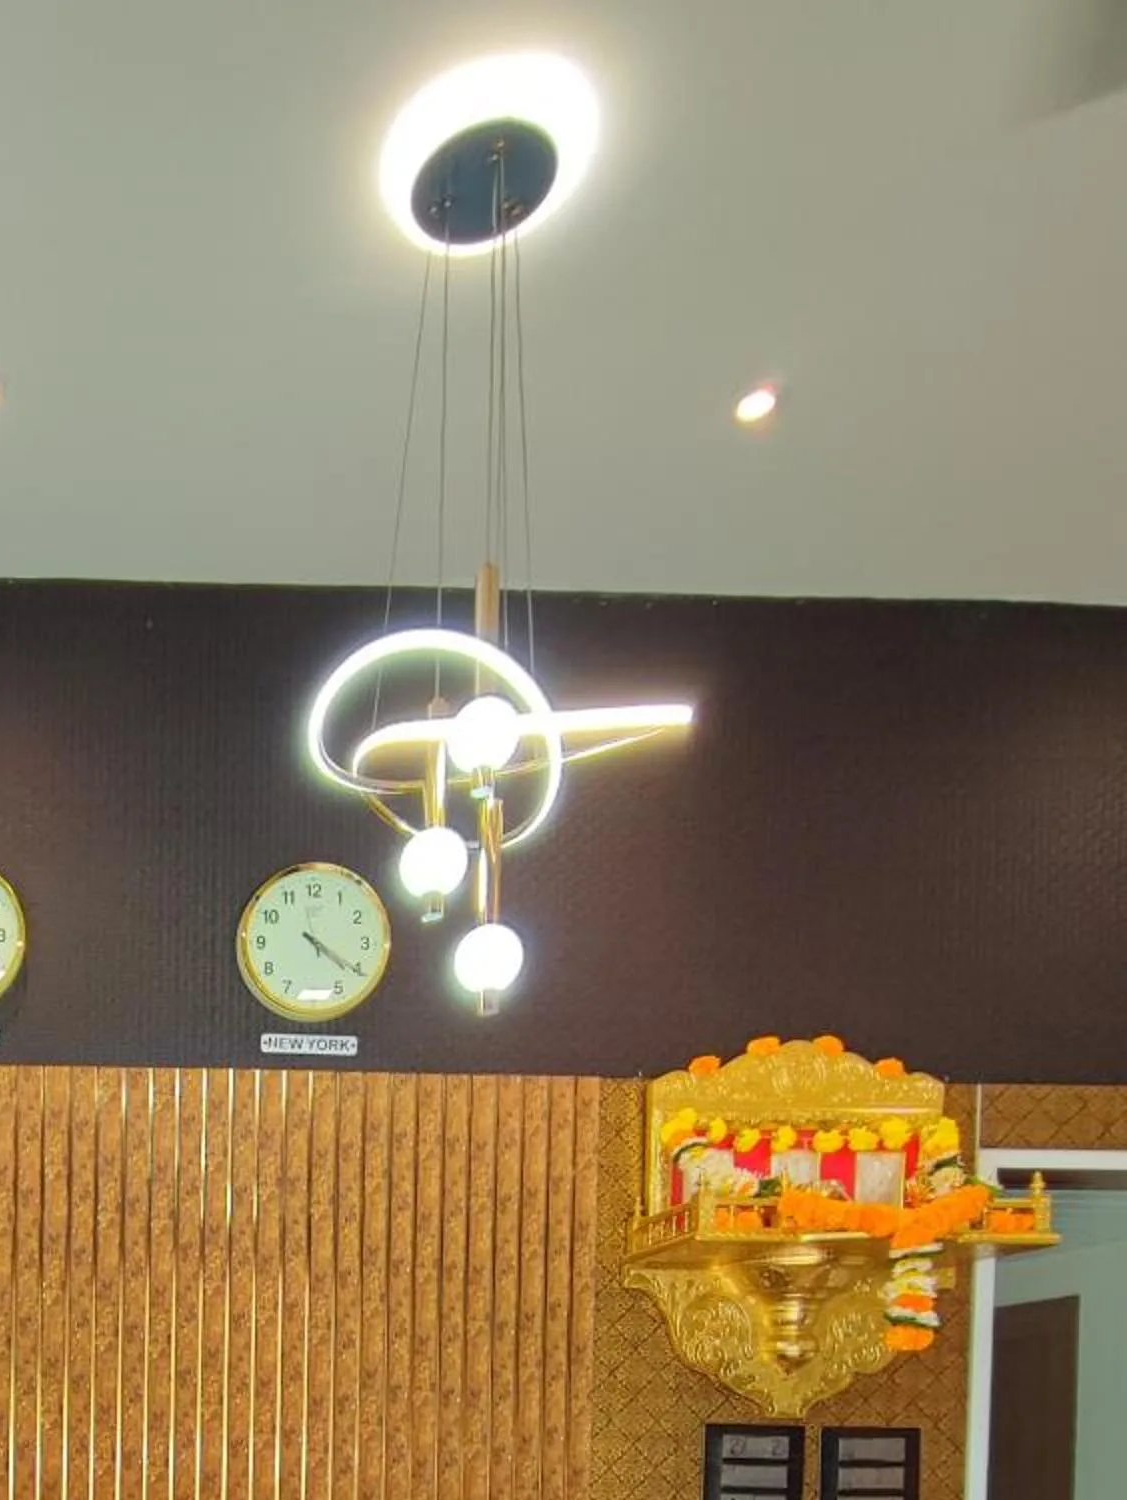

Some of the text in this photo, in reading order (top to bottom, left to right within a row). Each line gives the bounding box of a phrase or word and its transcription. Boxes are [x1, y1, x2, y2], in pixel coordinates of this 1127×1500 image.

[306, 884, 322, 897] 12
[282, 891, 295, 904] 11
[338, 891, 342, 904] 1
[263, 910, 279, 924] 10
[353, 911, 362, 924] 2
[257, 936, 266, 949] 9
[361, 937, 369, 950] 3
[264, 962, 273, 975] 8
[352, 963, 362, 975] 4
[283, 981, 292, 993] 7
[334, 981, 343, 994] 5
[268, 1037, 351, 1051] NEW YORK
